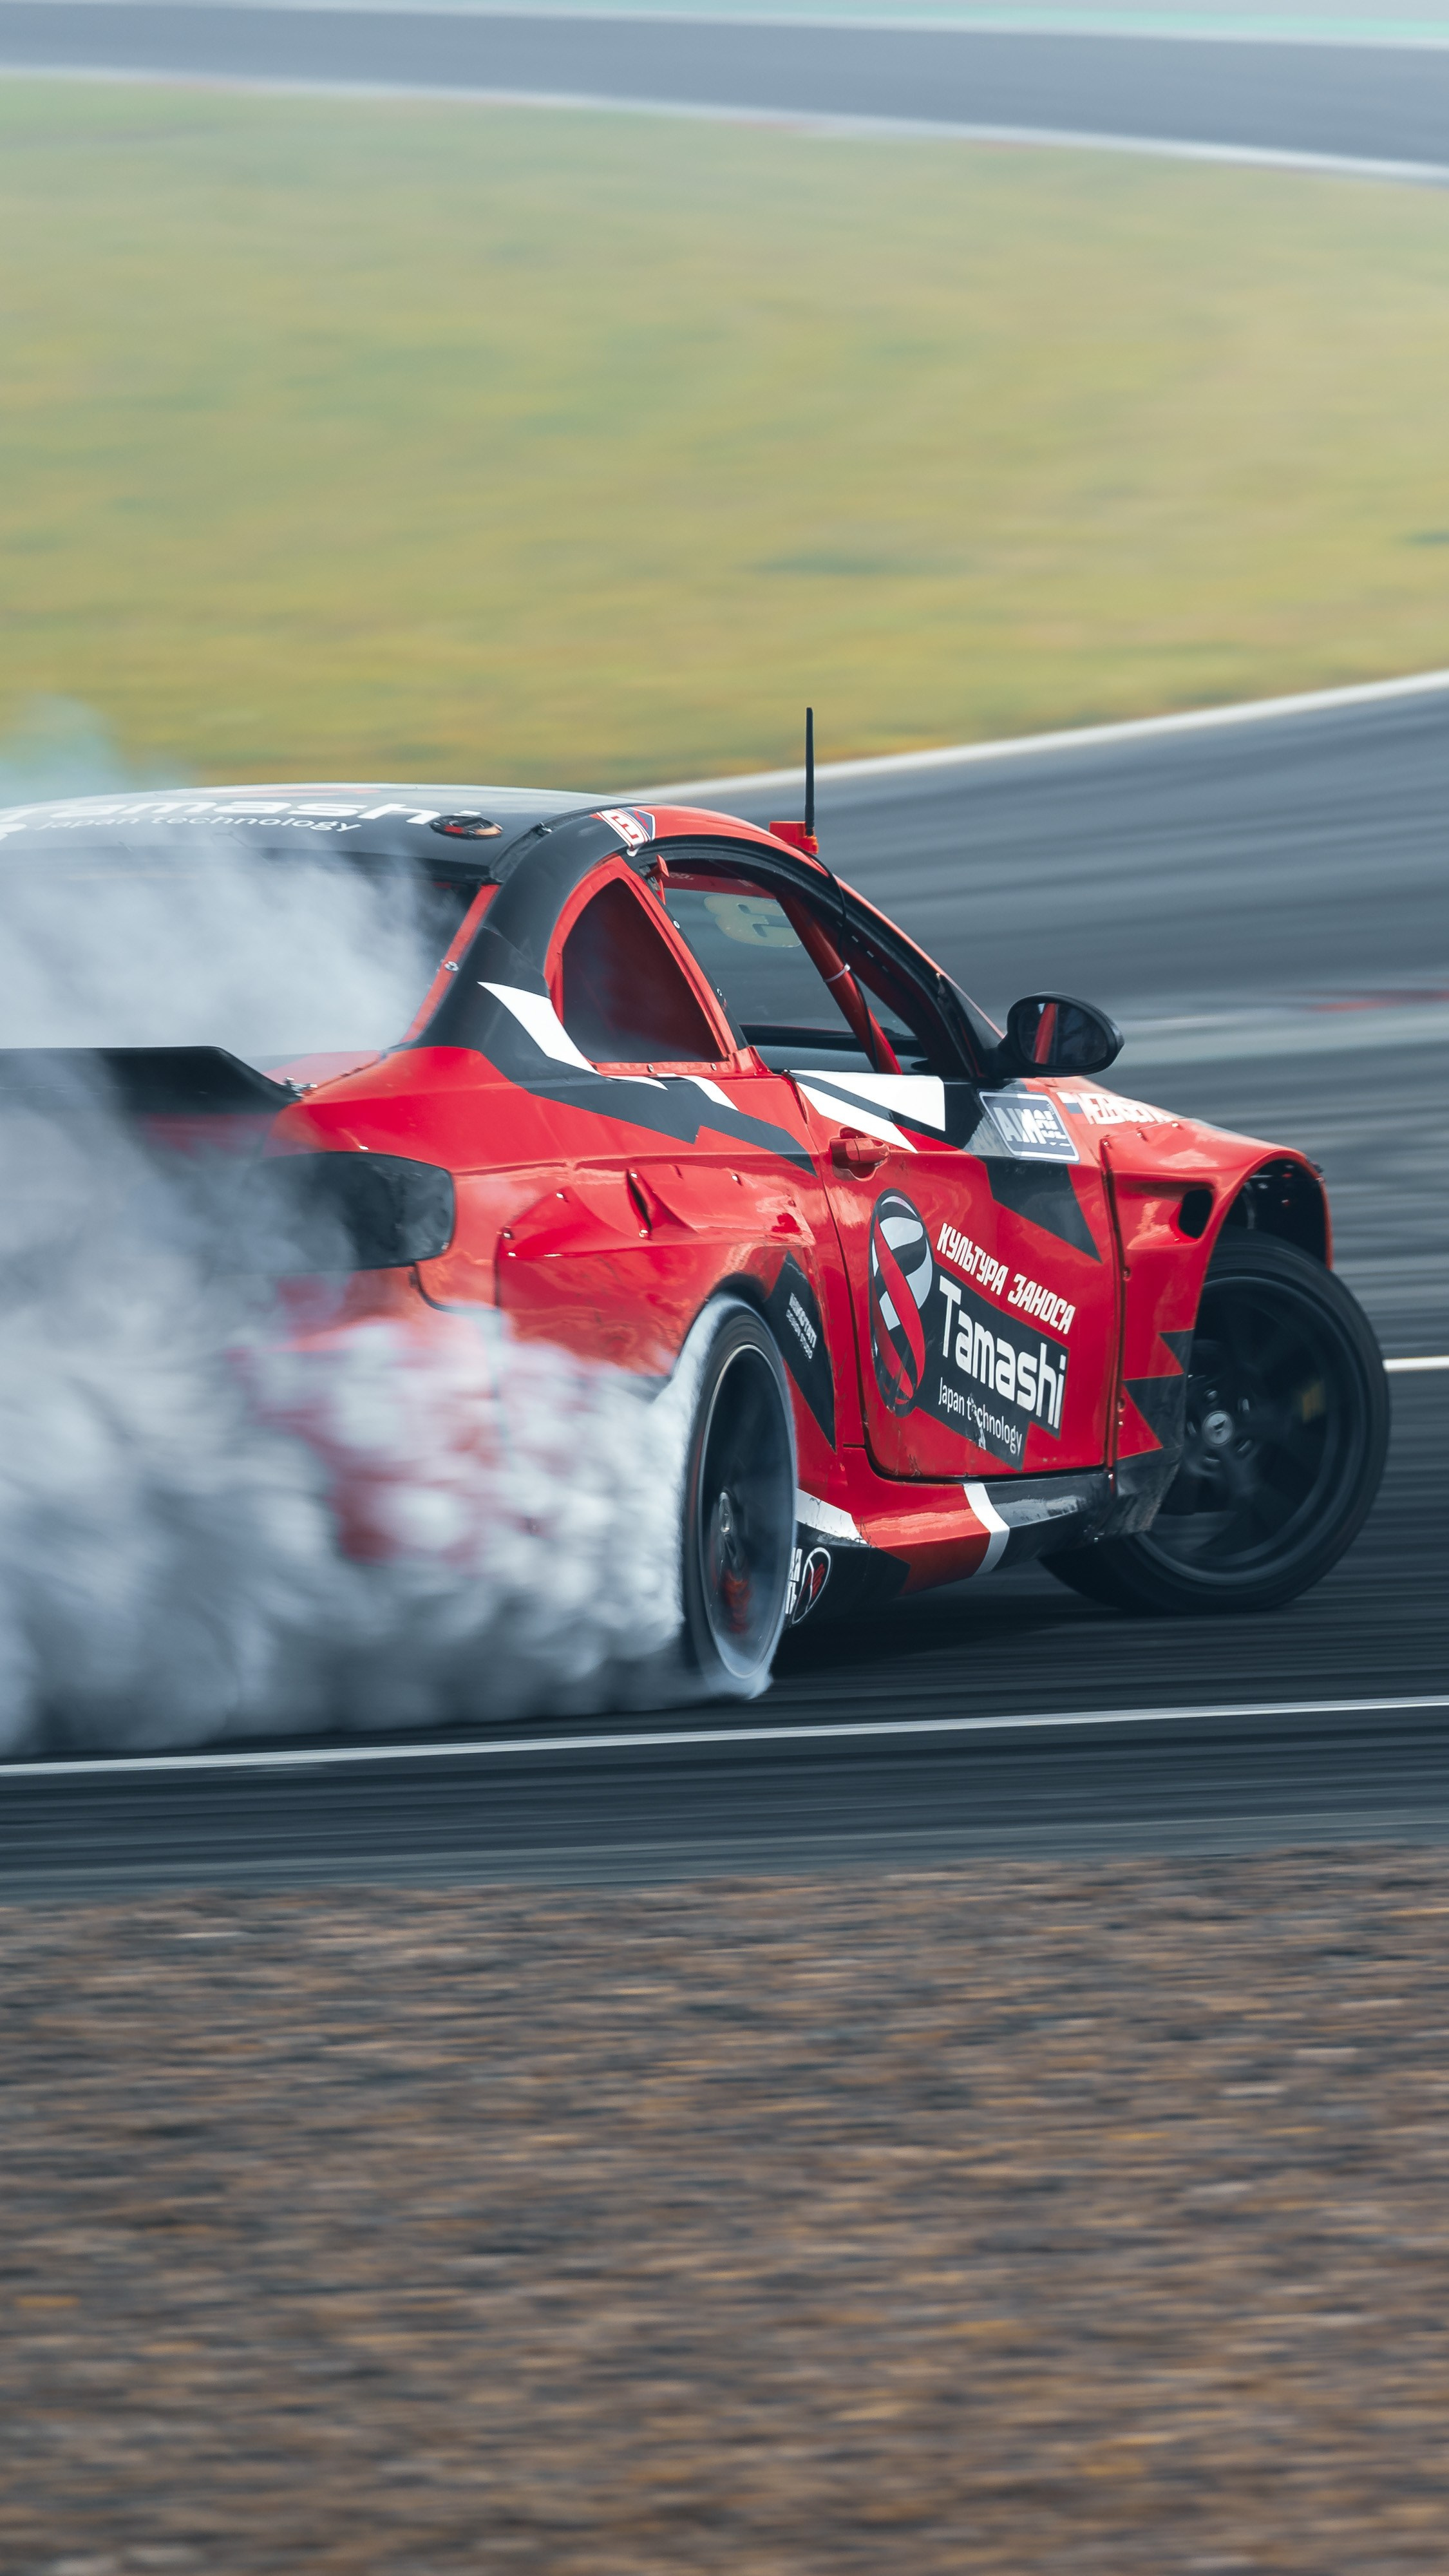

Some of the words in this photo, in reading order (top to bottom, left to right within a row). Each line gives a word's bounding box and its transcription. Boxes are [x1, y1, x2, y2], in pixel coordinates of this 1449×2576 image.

[151, 815, 362, 832] technology
[936, 1222, 1009, 1296] КУЛЬТУРА
[1007, 1273, 1076, 1335] ЗАНОСА
[939, 1274, 1066, 1429] Tamashi
[938, 1376, 965, 1416] Japan
